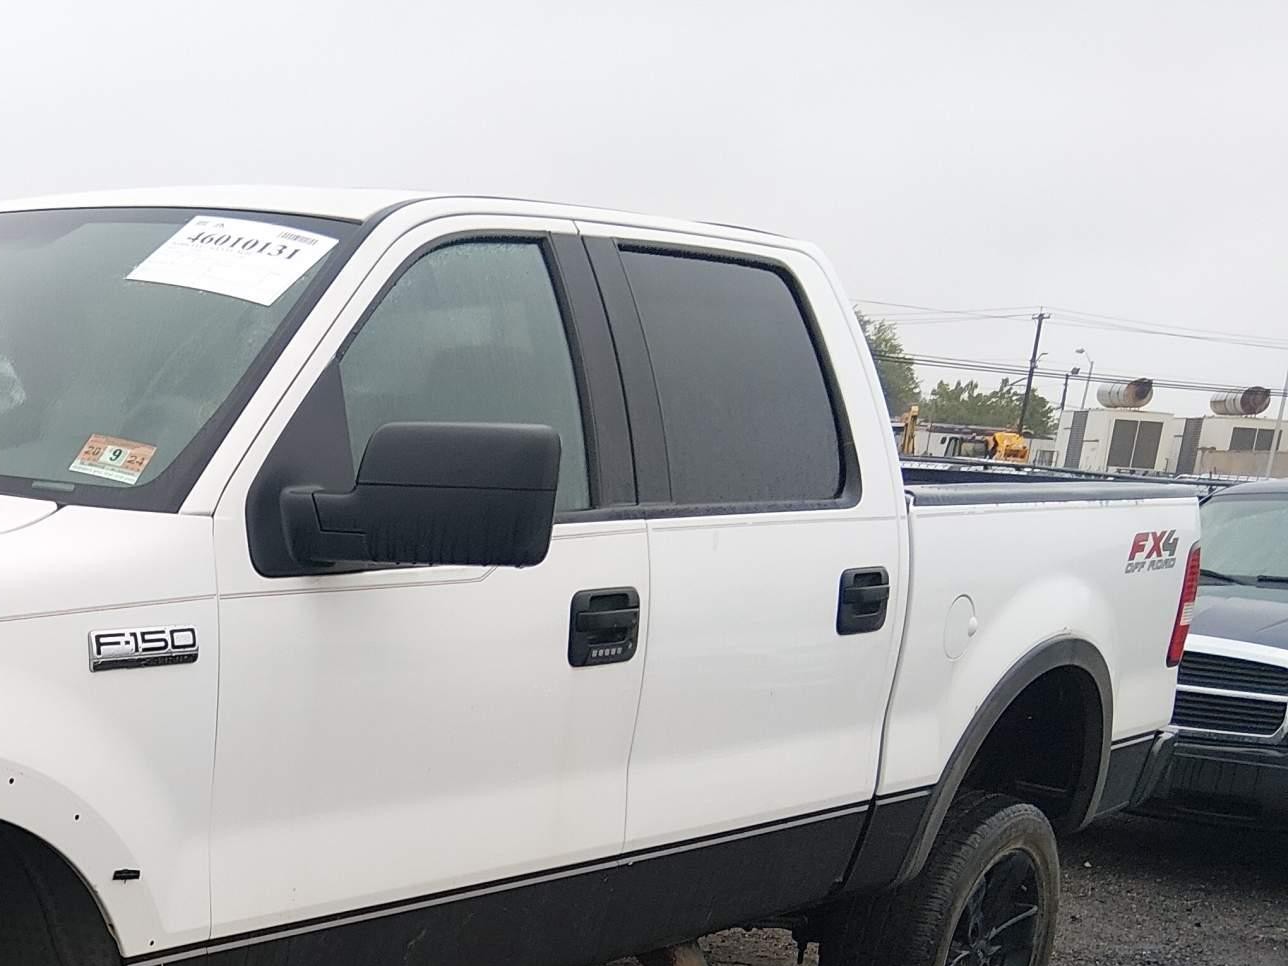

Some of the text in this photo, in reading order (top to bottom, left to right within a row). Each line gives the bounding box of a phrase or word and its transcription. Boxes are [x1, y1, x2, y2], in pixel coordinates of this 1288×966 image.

[187, 231, 301, 260] 46010131
[109, 448, 123, 462] 9
[1127, 528, 1179, 562] FX4
[1124, 557, 1177, 575] OFF ROAD
[94, 627, 198, 657] F-150
